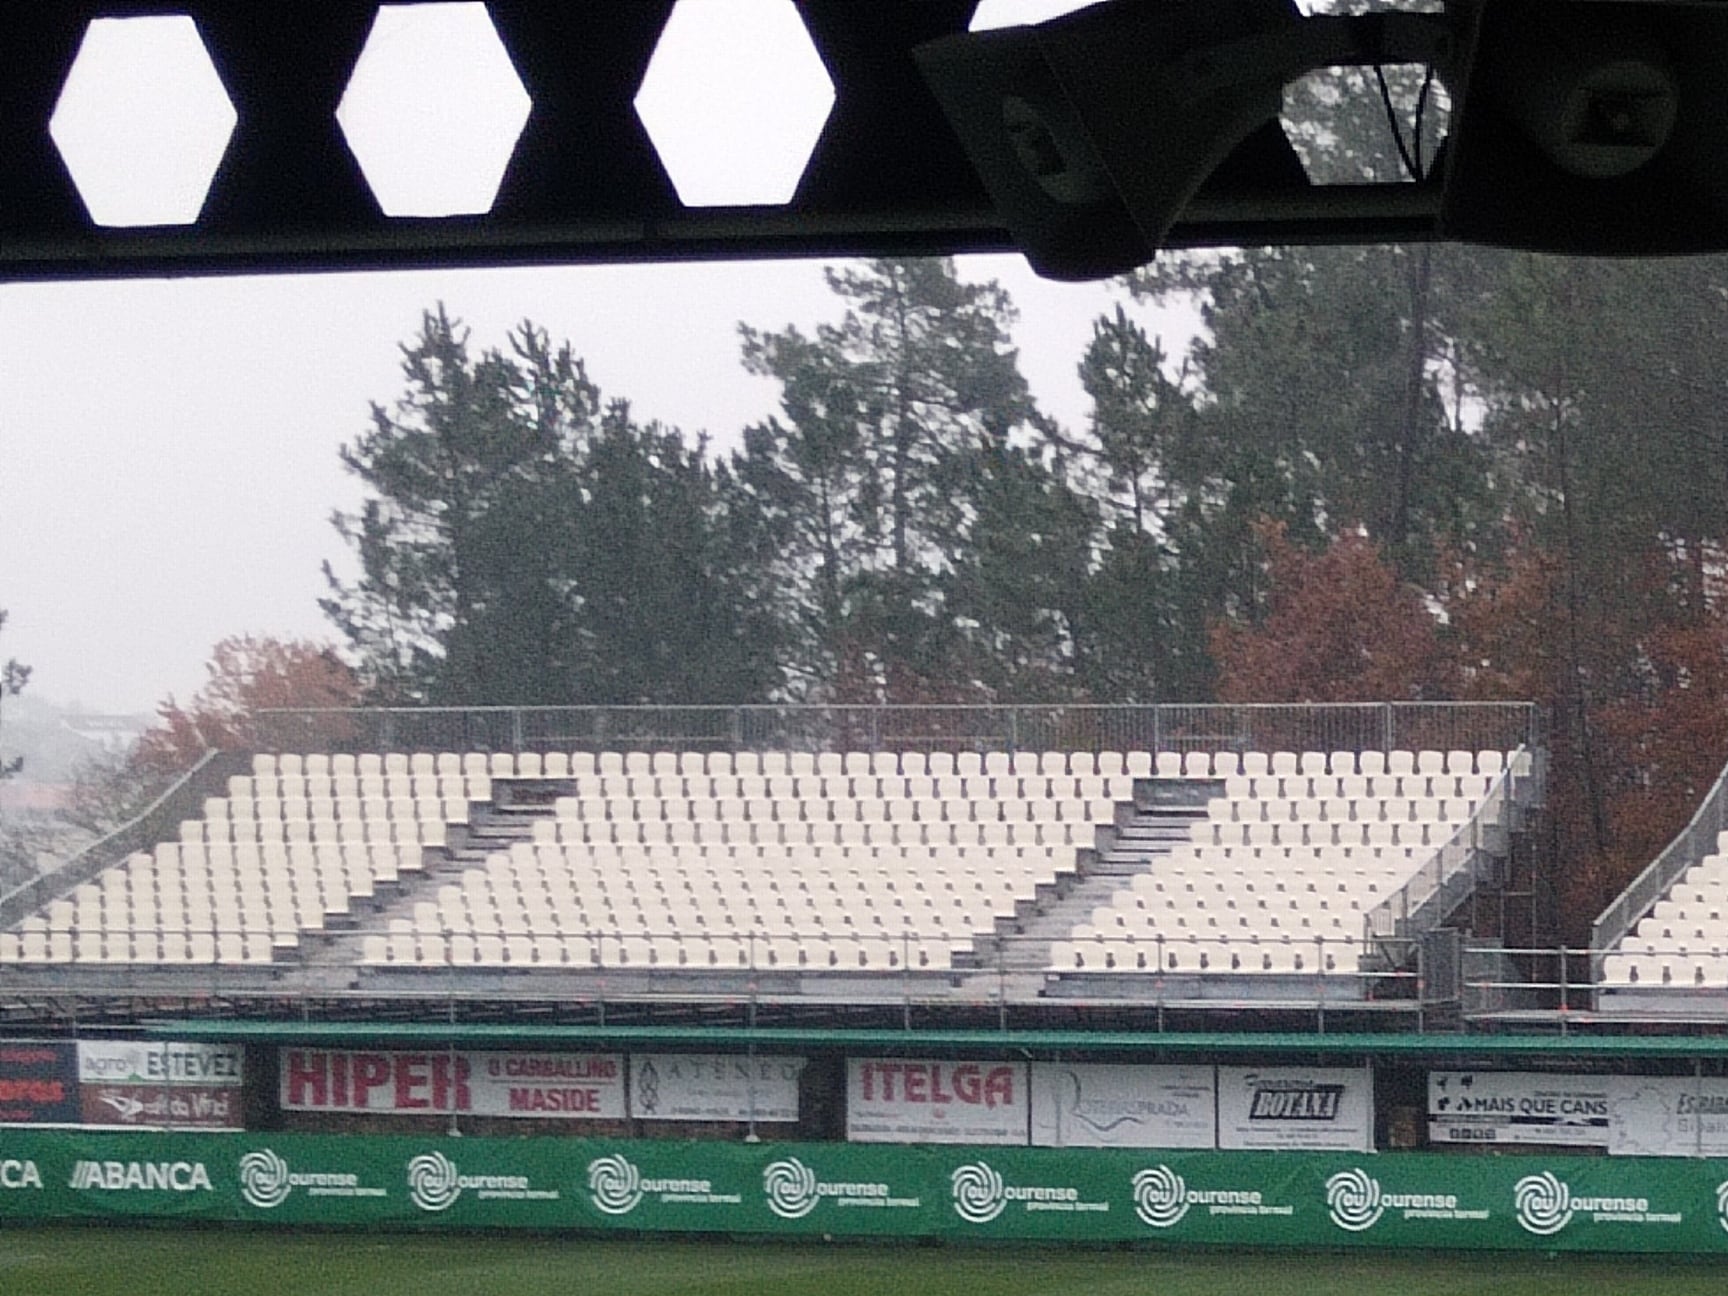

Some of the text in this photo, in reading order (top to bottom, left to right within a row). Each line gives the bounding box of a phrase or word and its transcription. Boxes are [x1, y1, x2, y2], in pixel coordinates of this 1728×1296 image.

[288, 1051, 472, 1109] HIPER
[861, 1063, 1013, 1110] ITELGA
[509, 1088, 601, 1112] MASIDE
[1475, 1098, 1608, 1115] MAIS QUE CANS
[0, 1160, 43, 1188] CA
[289, 1173, 358, 1186] ourense
[458, 1176, 528, 1188] ourense
[640, 1179, 711, 1192] ourense
[816, 1182, 888, 1196] ourense
[1004, 1186, 1078, 1200] ourense
[1186, 1191, 1262, 1204] ourense
[1381, 1194, 1456, 1208] ourense
[1570, 1197, 1648, 1211] ourense
